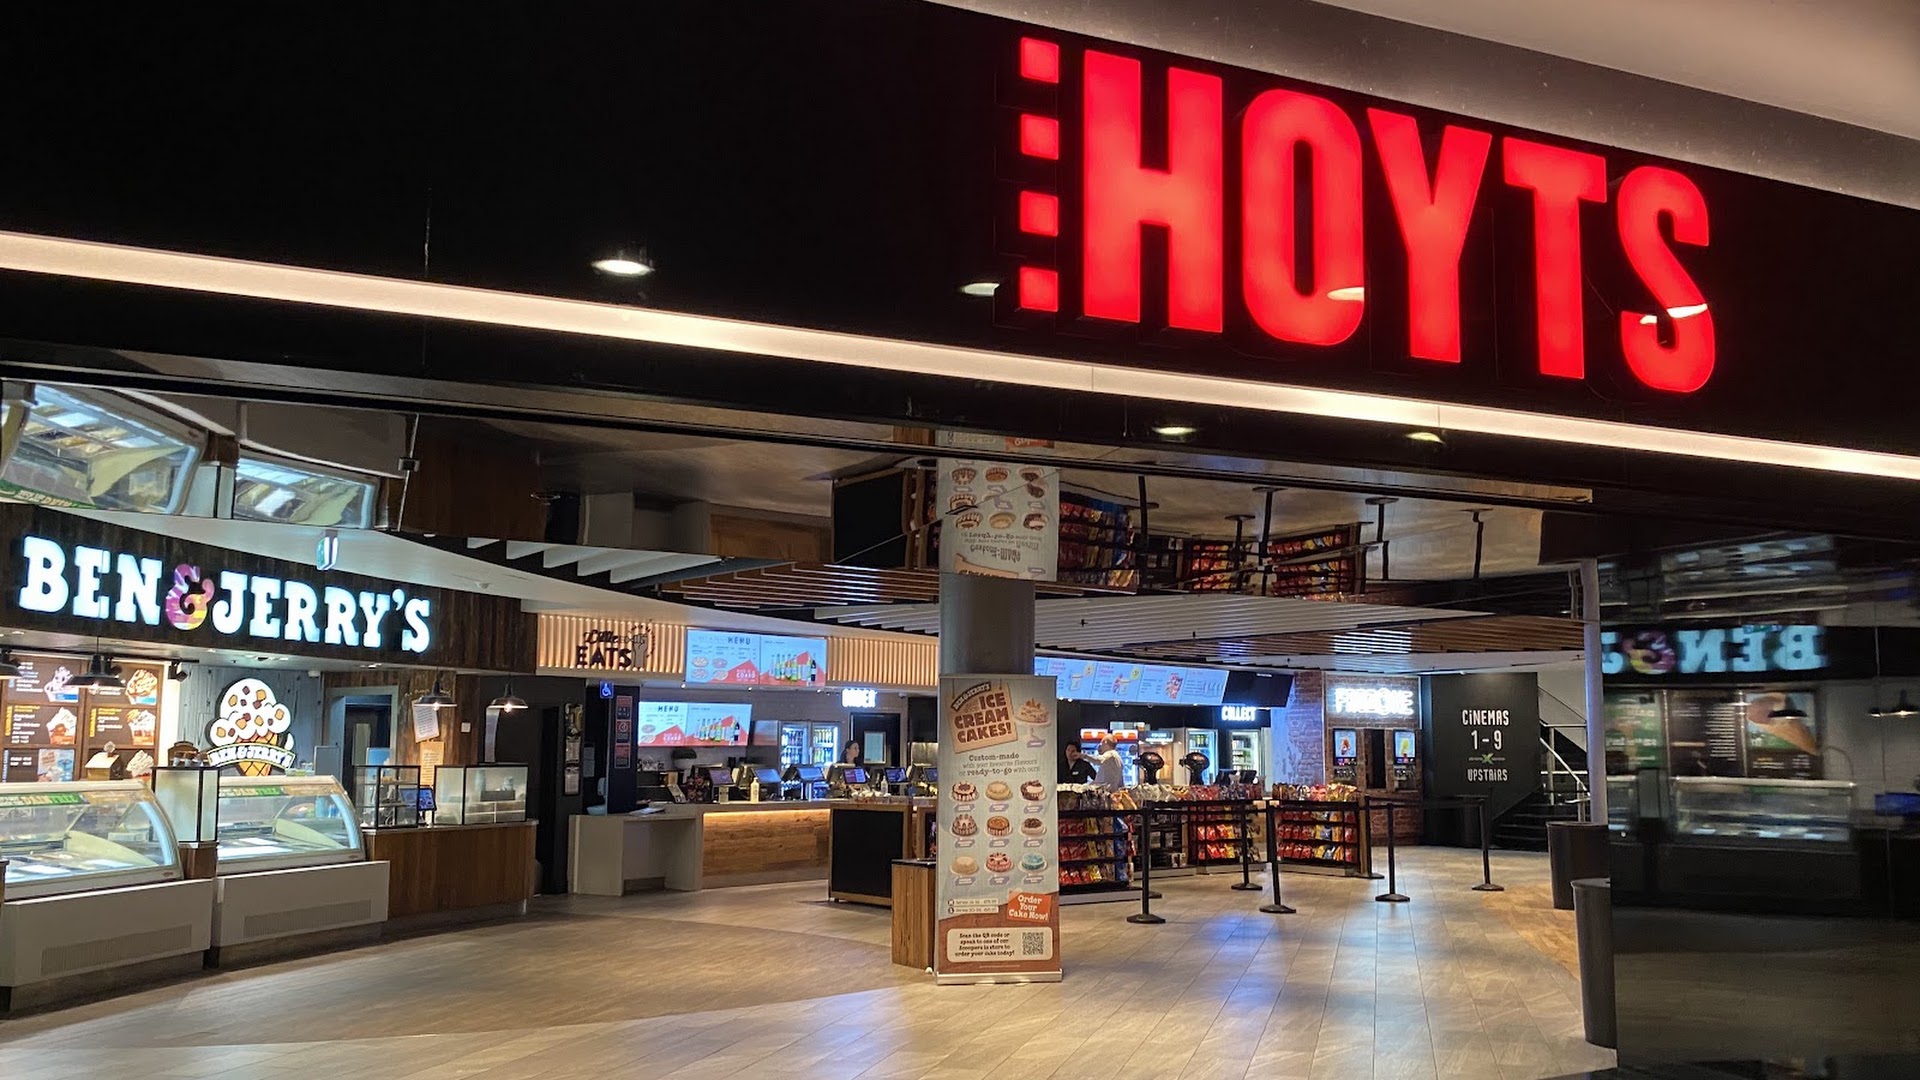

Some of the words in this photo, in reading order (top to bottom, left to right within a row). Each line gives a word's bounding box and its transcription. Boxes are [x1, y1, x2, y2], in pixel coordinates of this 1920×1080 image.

[1083, 50, 1716, 393] HOYTS
[18, 535, 163, 626] BEN
[212, 570, 431, 654] JERRY'S
[727, 636, 751, 645] MENU
[576, 645, 632, 667] EATS
[979, 692, 1006, 710] ICE
[657, 705, 679, 713] MENU
[954, 707, 1009, 729] CREAM
[957, 722, 1012, 743] CAKES!
[969, 752, 1019, 762] Custom-made
[967, 767, 1012, 776] ready-to-go
[1018, 894, 1042, 904] Order
[1020, 903, 1037, 911] Your
[1009, 909, 1027, 918] Cake
[1029, 910, 1049, 921] Now!
